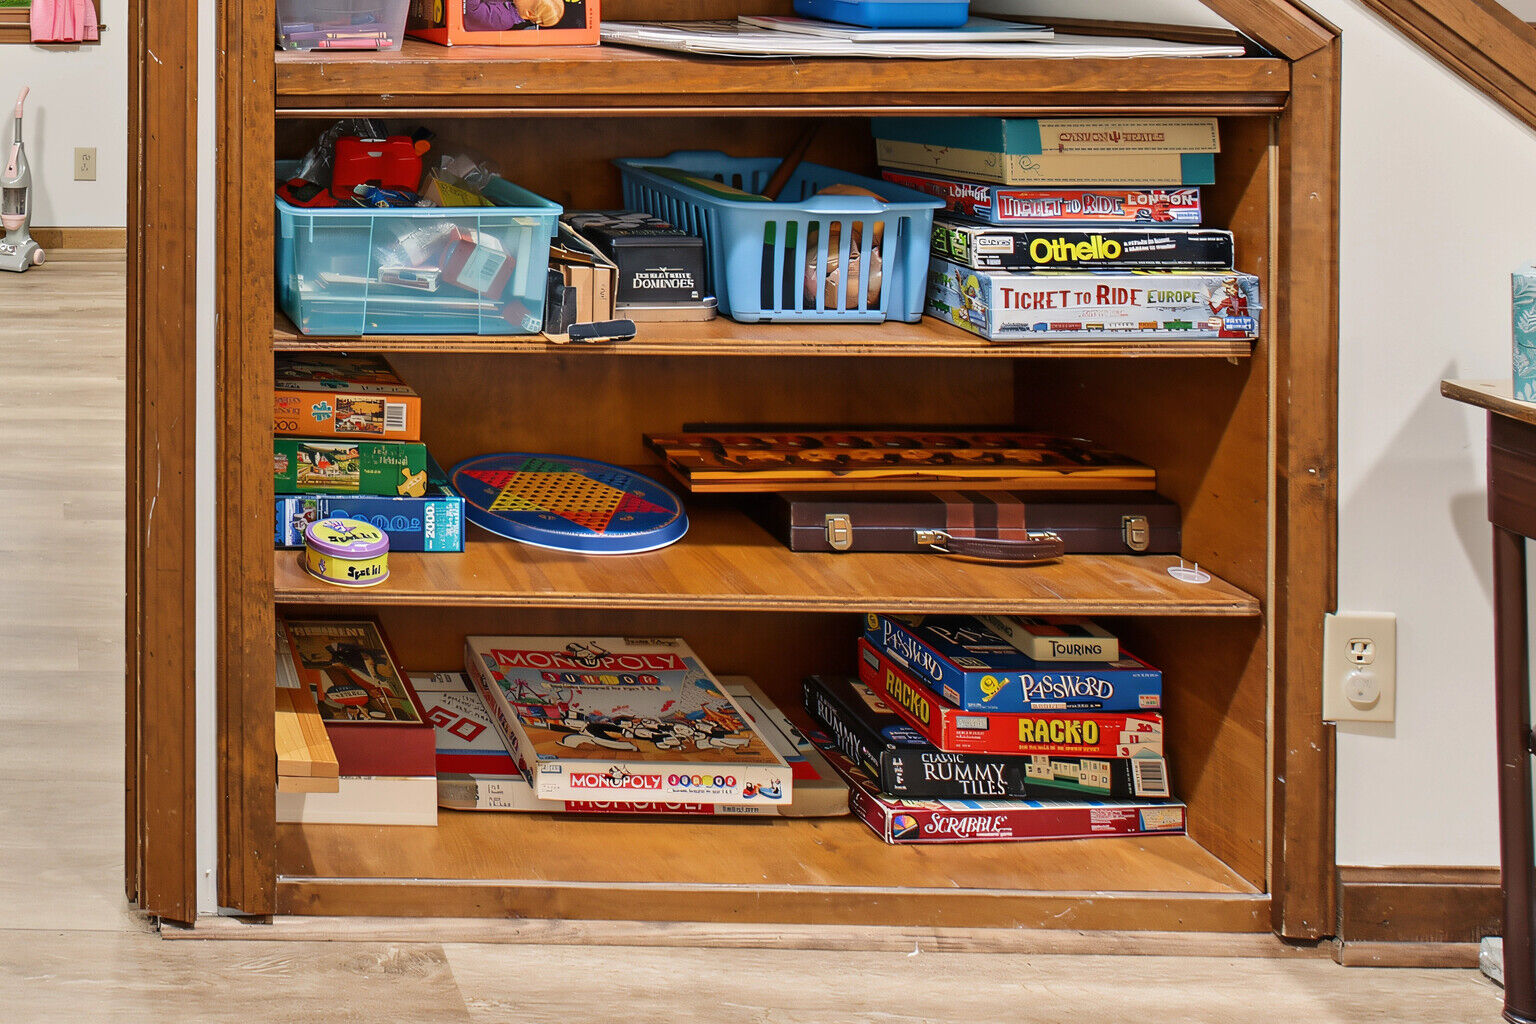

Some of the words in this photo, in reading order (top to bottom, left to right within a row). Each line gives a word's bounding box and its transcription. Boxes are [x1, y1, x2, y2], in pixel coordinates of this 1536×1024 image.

[1082, 193, 1126, 216] RIDE
[1029, 235, 1122, 264] Othello
[632, 278, 695, 289] DOMINOES
[1000, 287, 1071, 310] TICKET
[1096, 284, 1143, 307] RIDE
[1147, 289, 1201, 304] EUROPE
[1048, 640, 1102, 657] TOURING
[498, 651, 675, 670] MONOPOLY
[1018, 674, 1114, 703] PASSWORD
[426, 705, 488, 743] GO
[571, 774, 661, 789] MONOPOLY
[924, 763, 1006, 782] RUMMY
[959, 780, 1006, 795] TILES
[924, 813, 1006, 838] SCRABBLE
